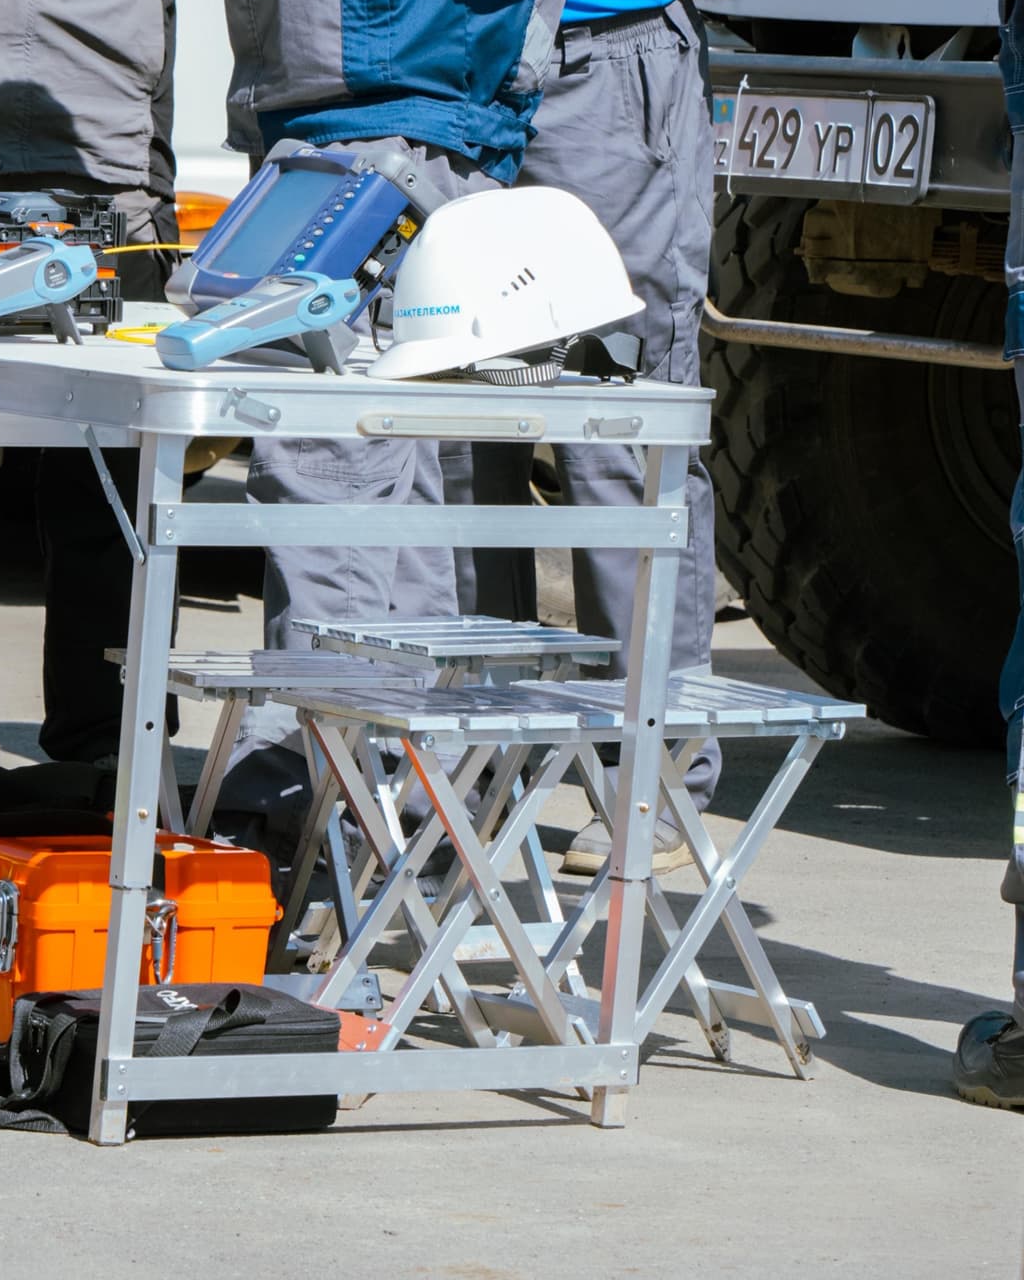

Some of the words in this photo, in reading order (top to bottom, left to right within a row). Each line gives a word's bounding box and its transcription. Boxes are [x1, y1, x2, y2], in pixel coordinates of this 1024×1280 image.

[714, 138, 730, 167] Z
[738, 104, 803, 170] 429
[872, 111, 920, 179] 02
